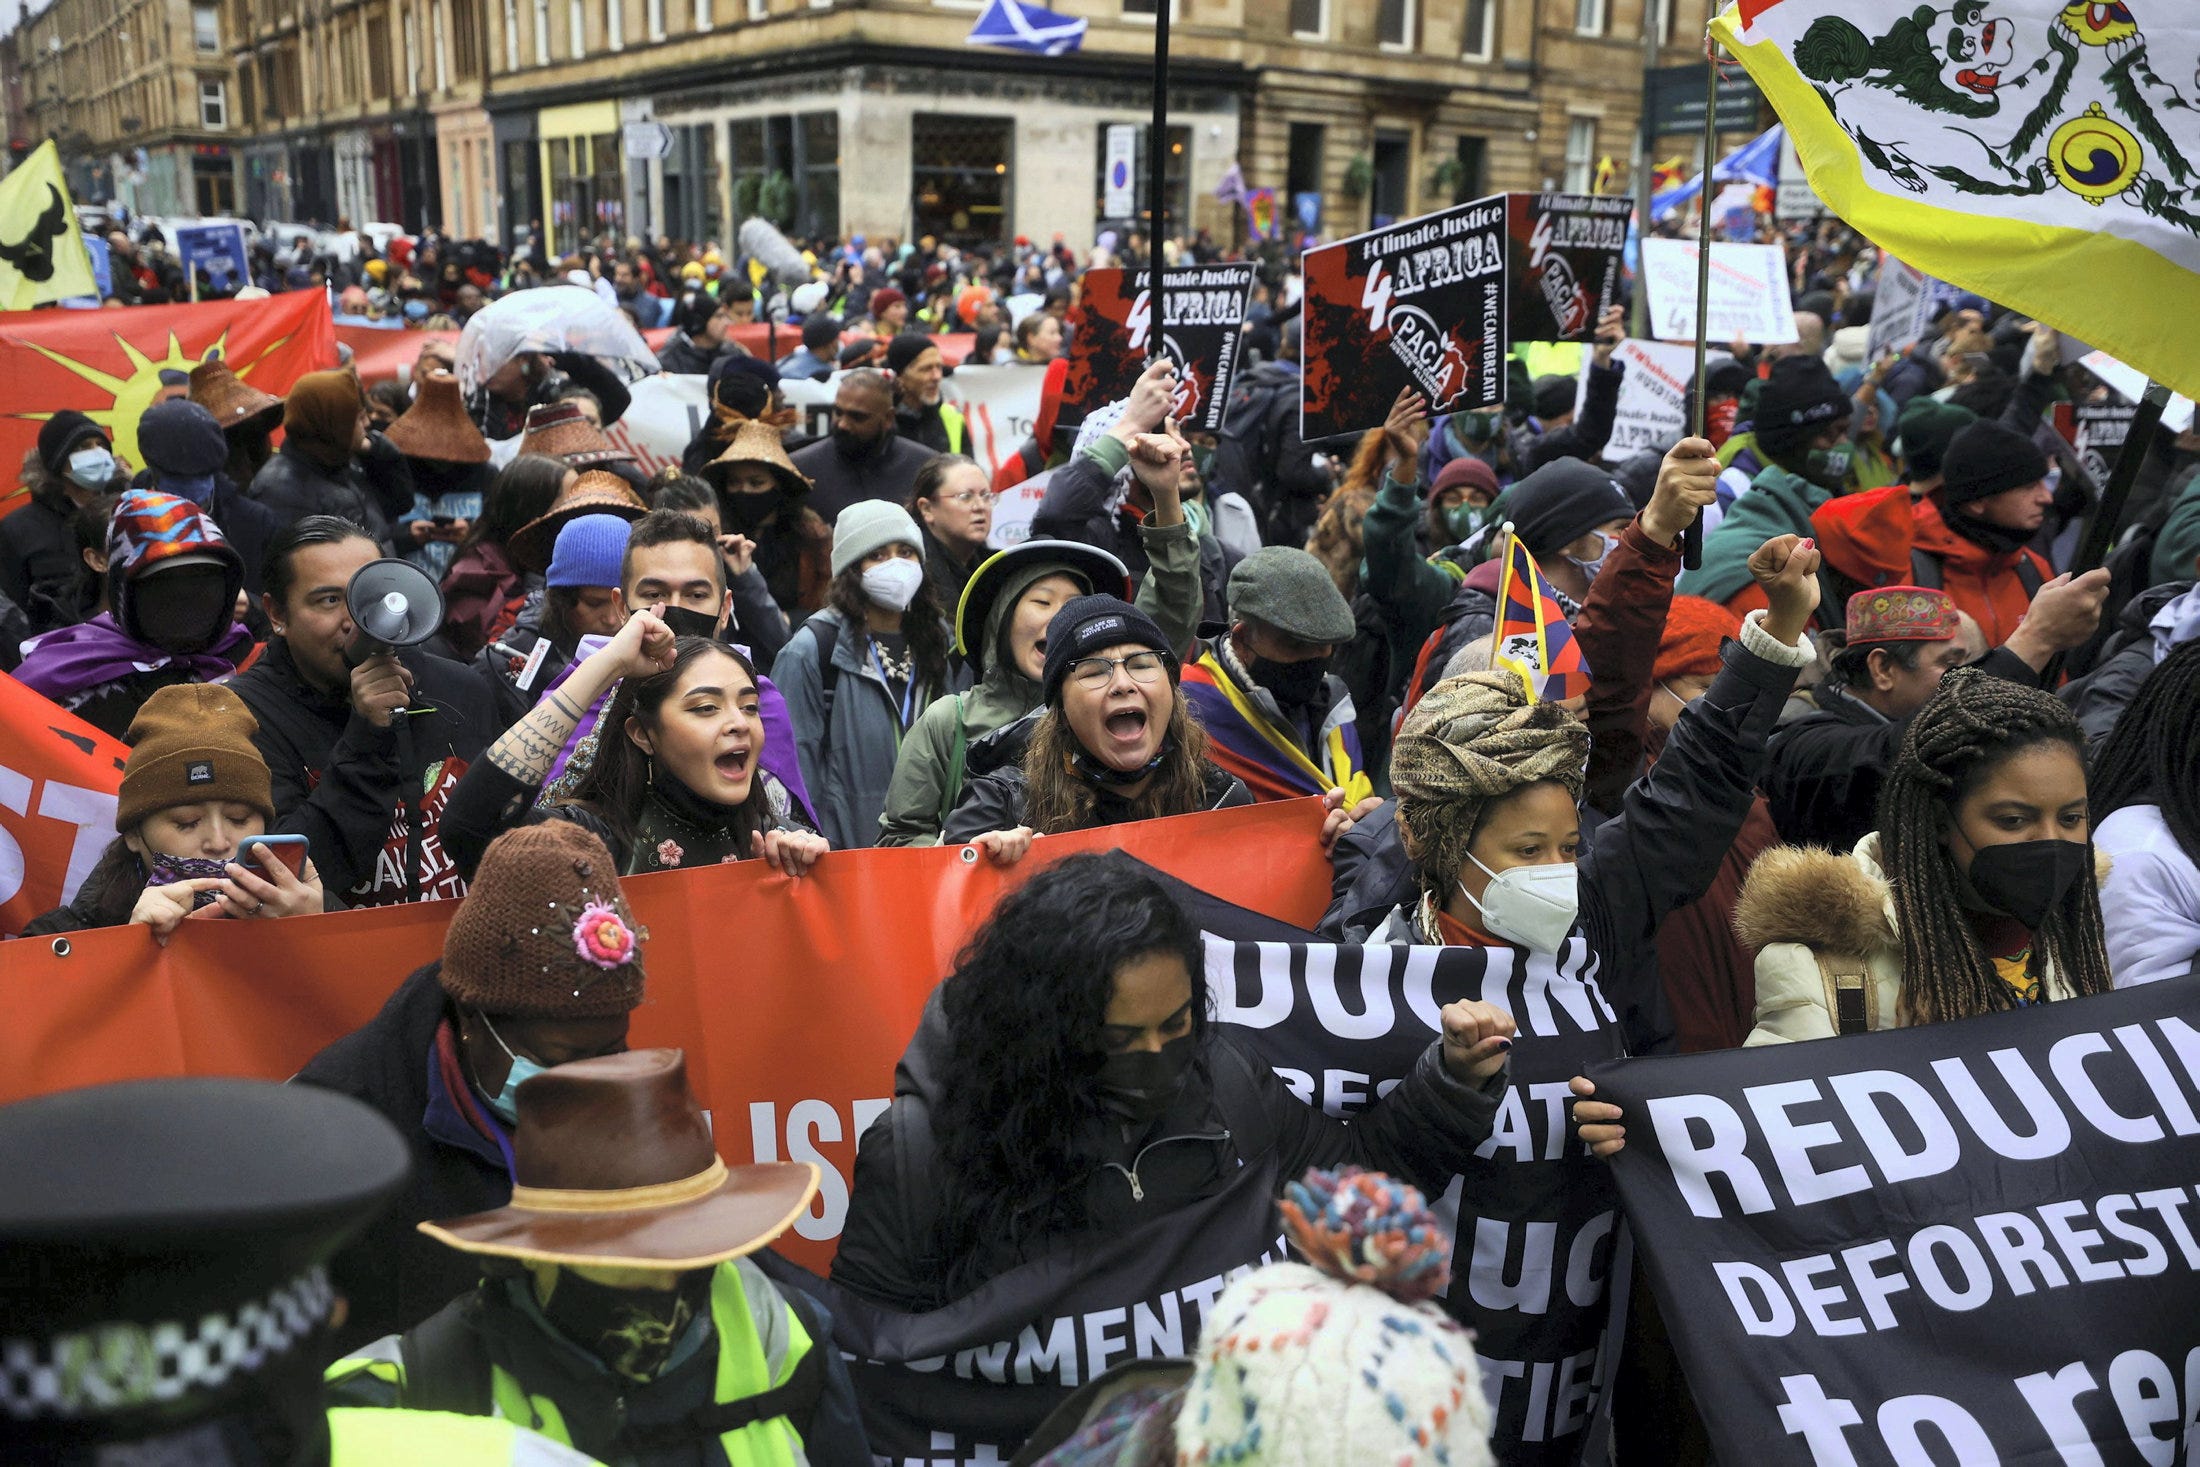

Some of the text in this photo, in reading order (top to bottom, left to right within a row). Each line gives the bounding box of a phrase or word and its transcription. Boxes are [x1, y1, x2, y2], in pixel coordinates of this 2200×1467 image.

[1363, 205, 1503, 260] #ClimateJustice
[1393, 231, 1503, 298] AFRICA
[1528, 211, 1553, 268] 4
[1551, 215, 1625, 250] AFRICA
[1361, 258, 1393, 332] 4
[1550, 262, 1580, 326] PACJA
[1396, 314, 1455, 388] PACJA
[1482, 280, 1499, 402] #WECANTBREATH
[1021, 487, 1046, 500] #W
[1004, 526, 1033, 540] PAC
[1082, 626, 1093, 634] YOU
[1094, 620, 1106, 628] ARE
[1082, 622, 1118, 639] NATIVE LAND
[1200, 929, 1618, 1040] DUCIN
[1711, 1184, 2200, 1338] DEFOREST
[2013, 1345, 2200, 1467] re
